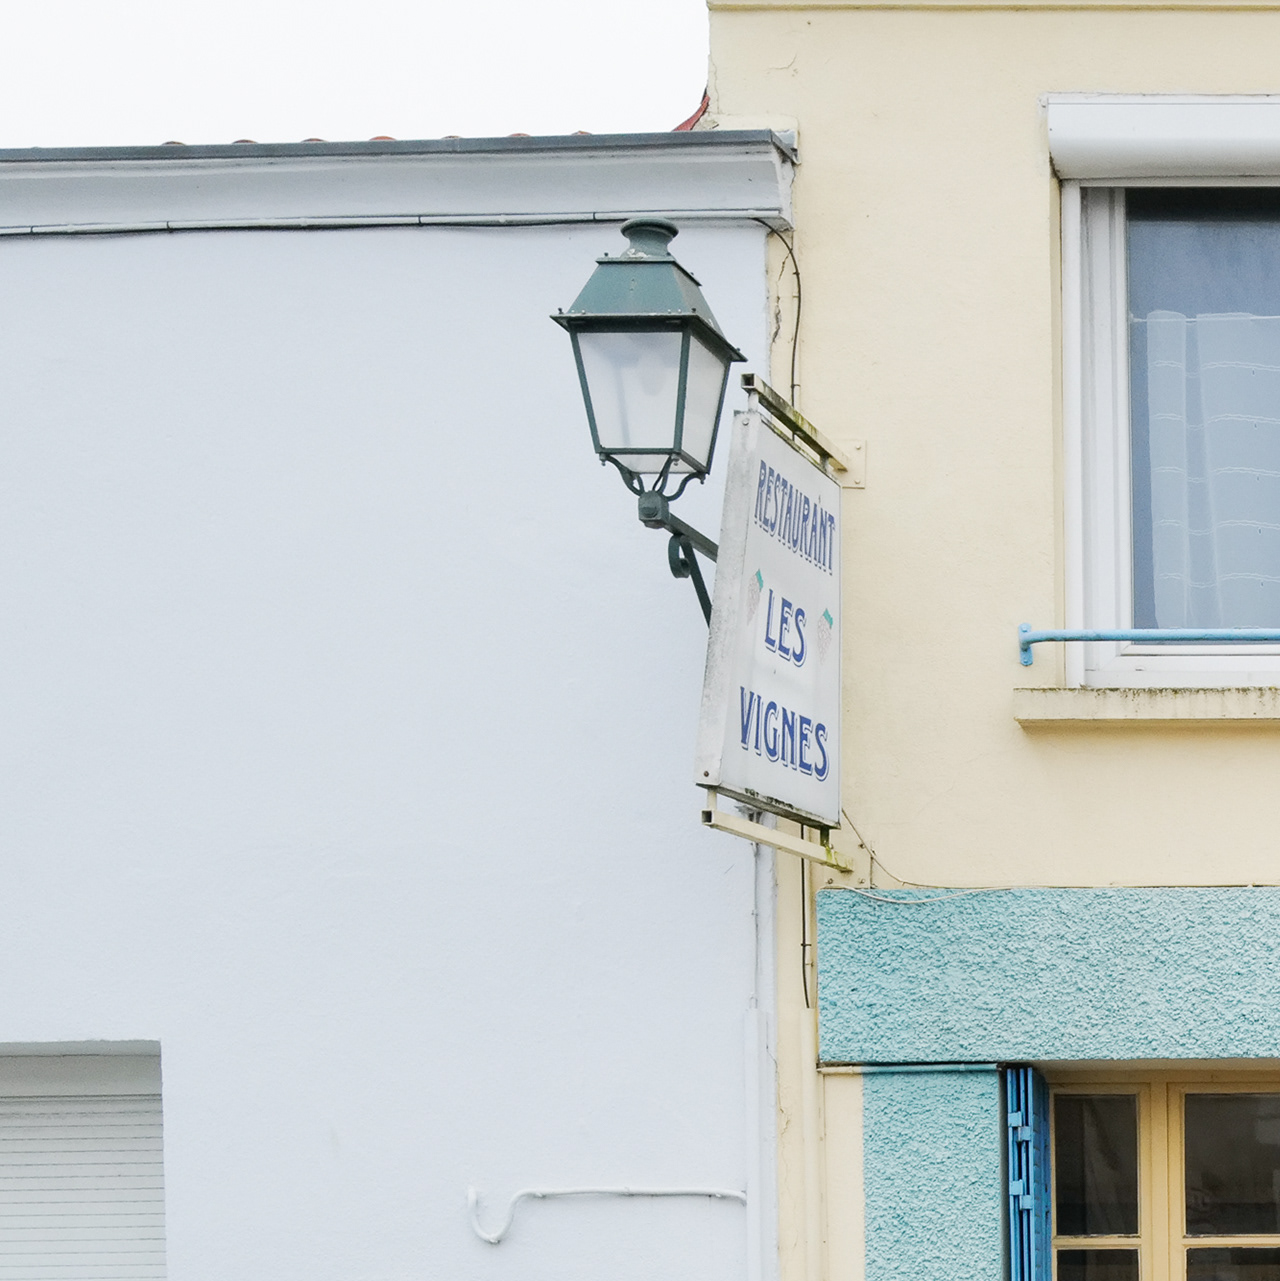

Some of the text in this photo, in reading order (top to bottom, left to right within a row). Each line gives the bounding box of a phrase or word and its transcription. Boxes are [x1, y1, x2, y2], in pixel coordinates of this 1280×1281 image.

[753, 458, 837, 576] RESTAURANT
[764, 588, 808, 668] LES
[739, 684, 831, 783] VIGNES
